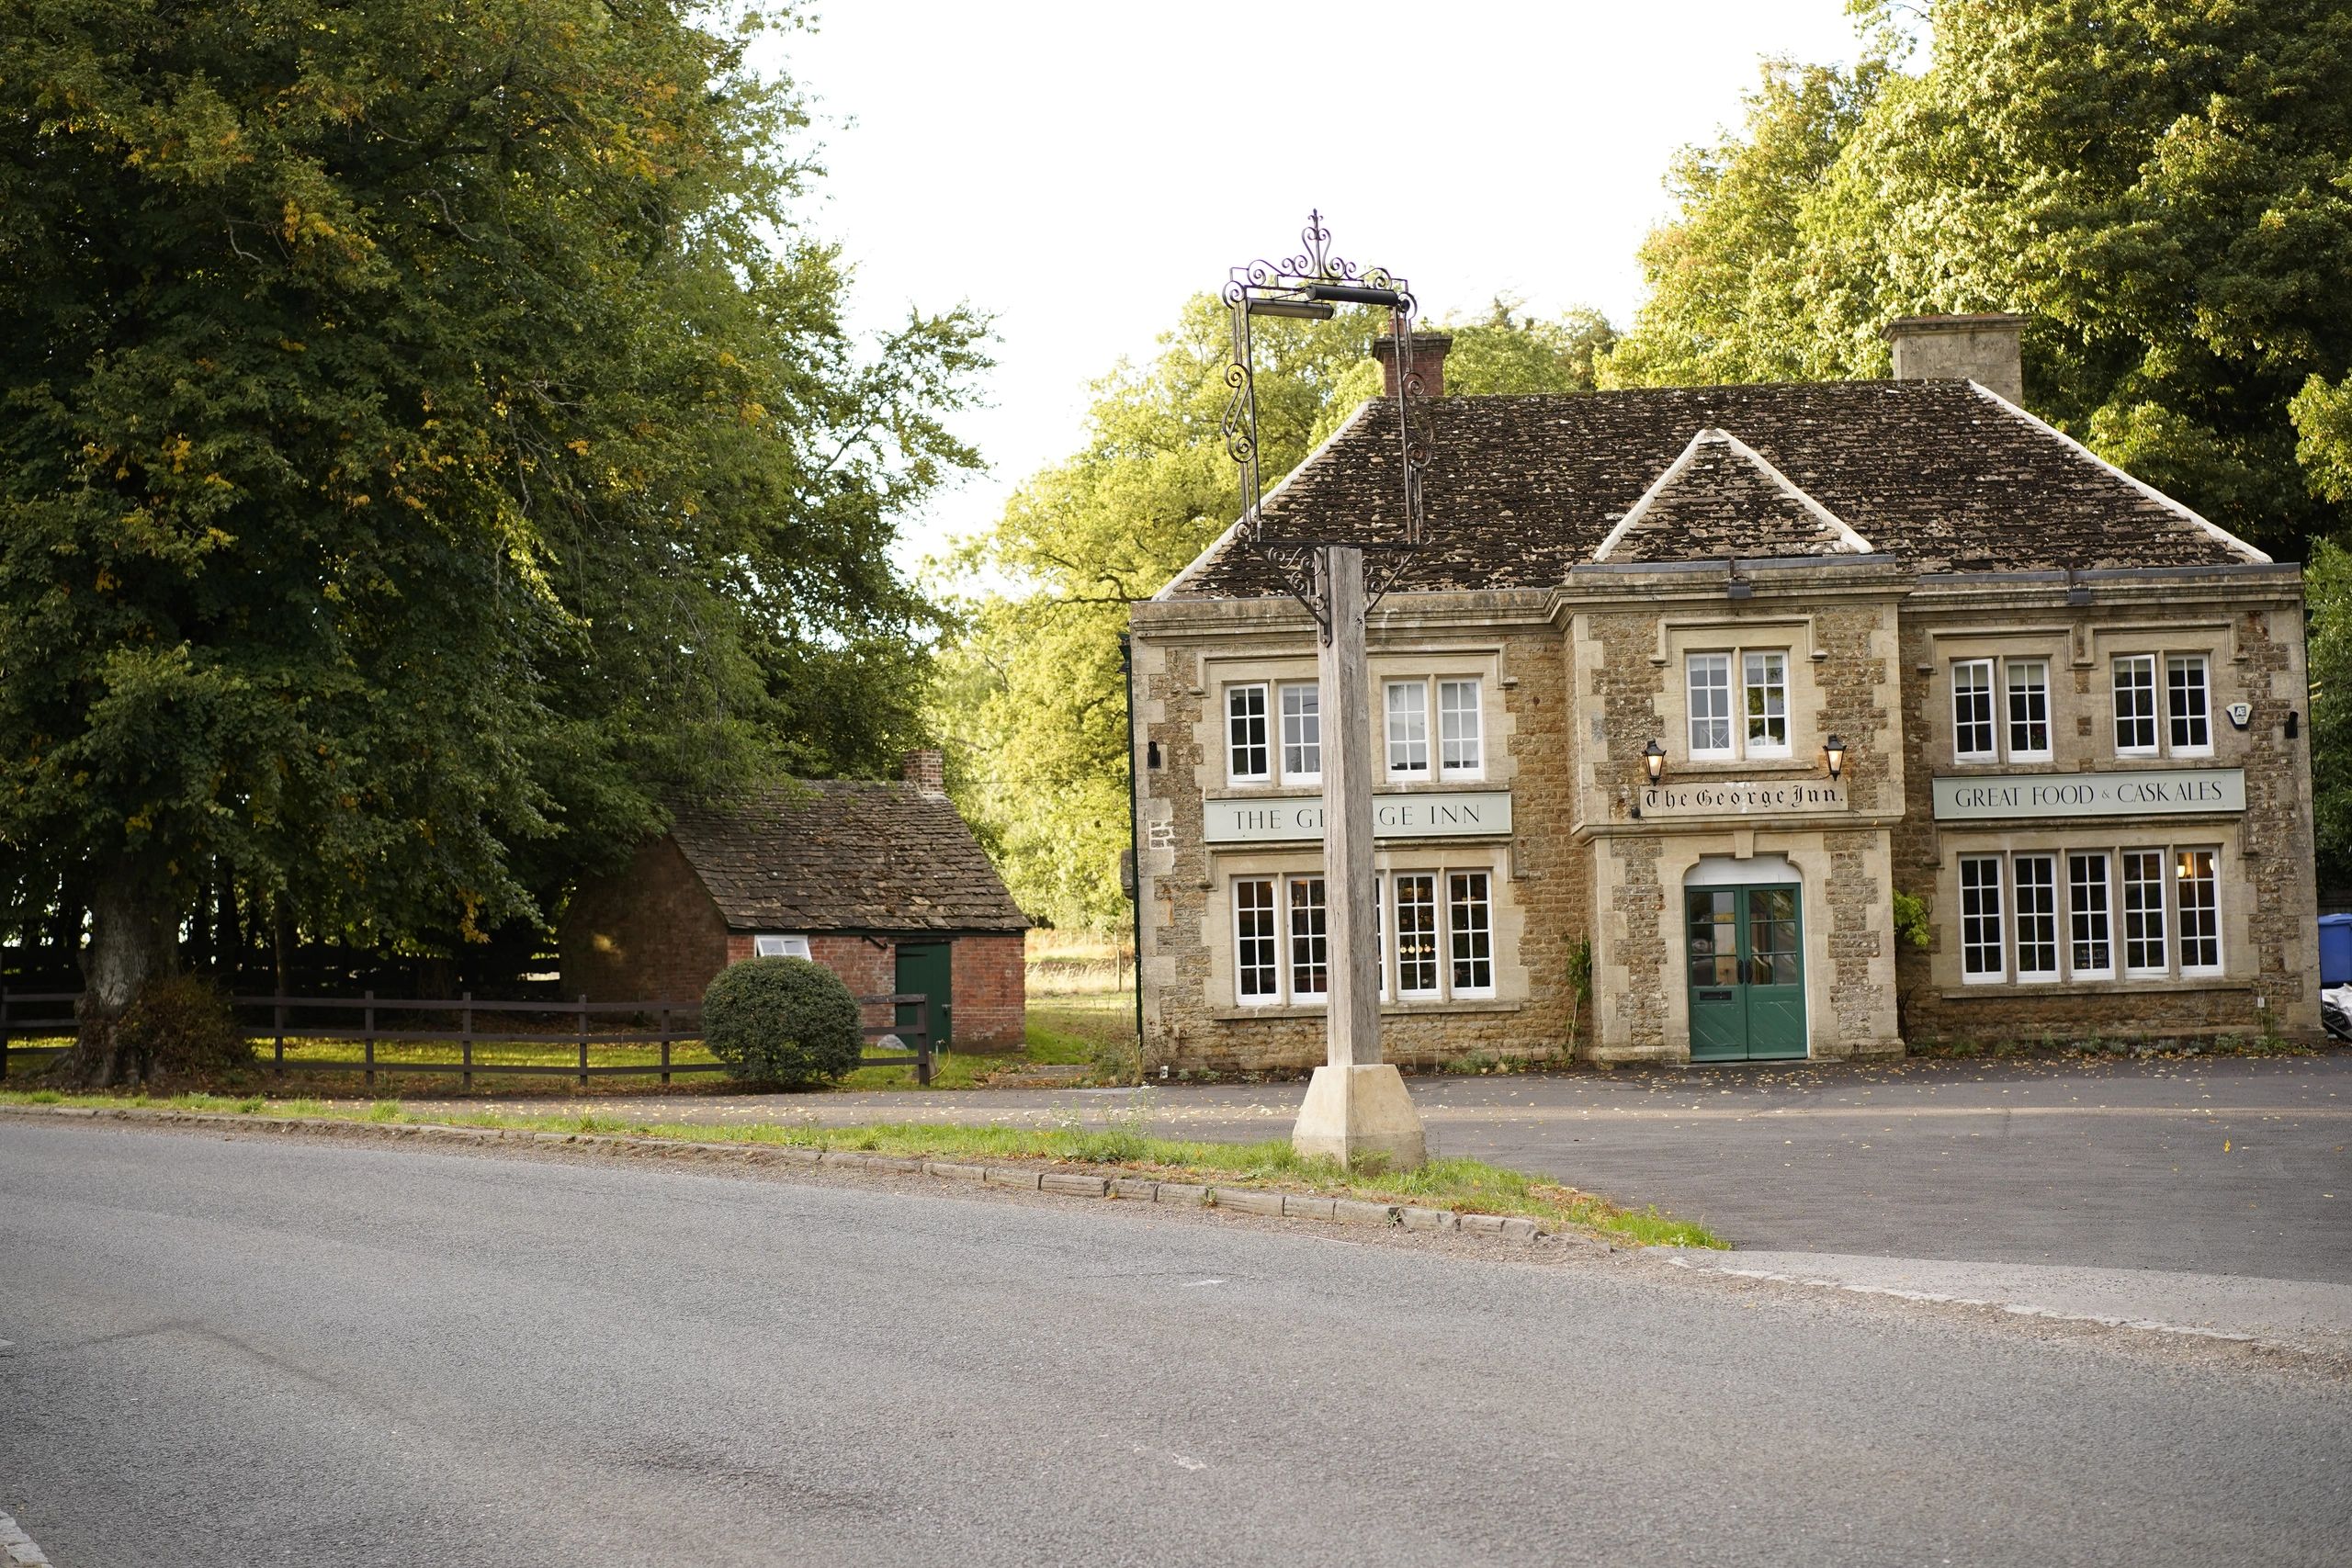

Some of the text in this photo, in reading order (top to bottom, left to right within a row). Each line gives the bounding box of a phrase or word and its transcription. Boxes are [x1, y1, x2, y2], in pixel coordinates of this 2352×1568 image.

[1645, 784, 1844, 809] The George Inn.
[1955, 780, 2222, 807] GREAT FOOD & CASK ALES
[1233, 805, 1479, 829] THE GGE INN
